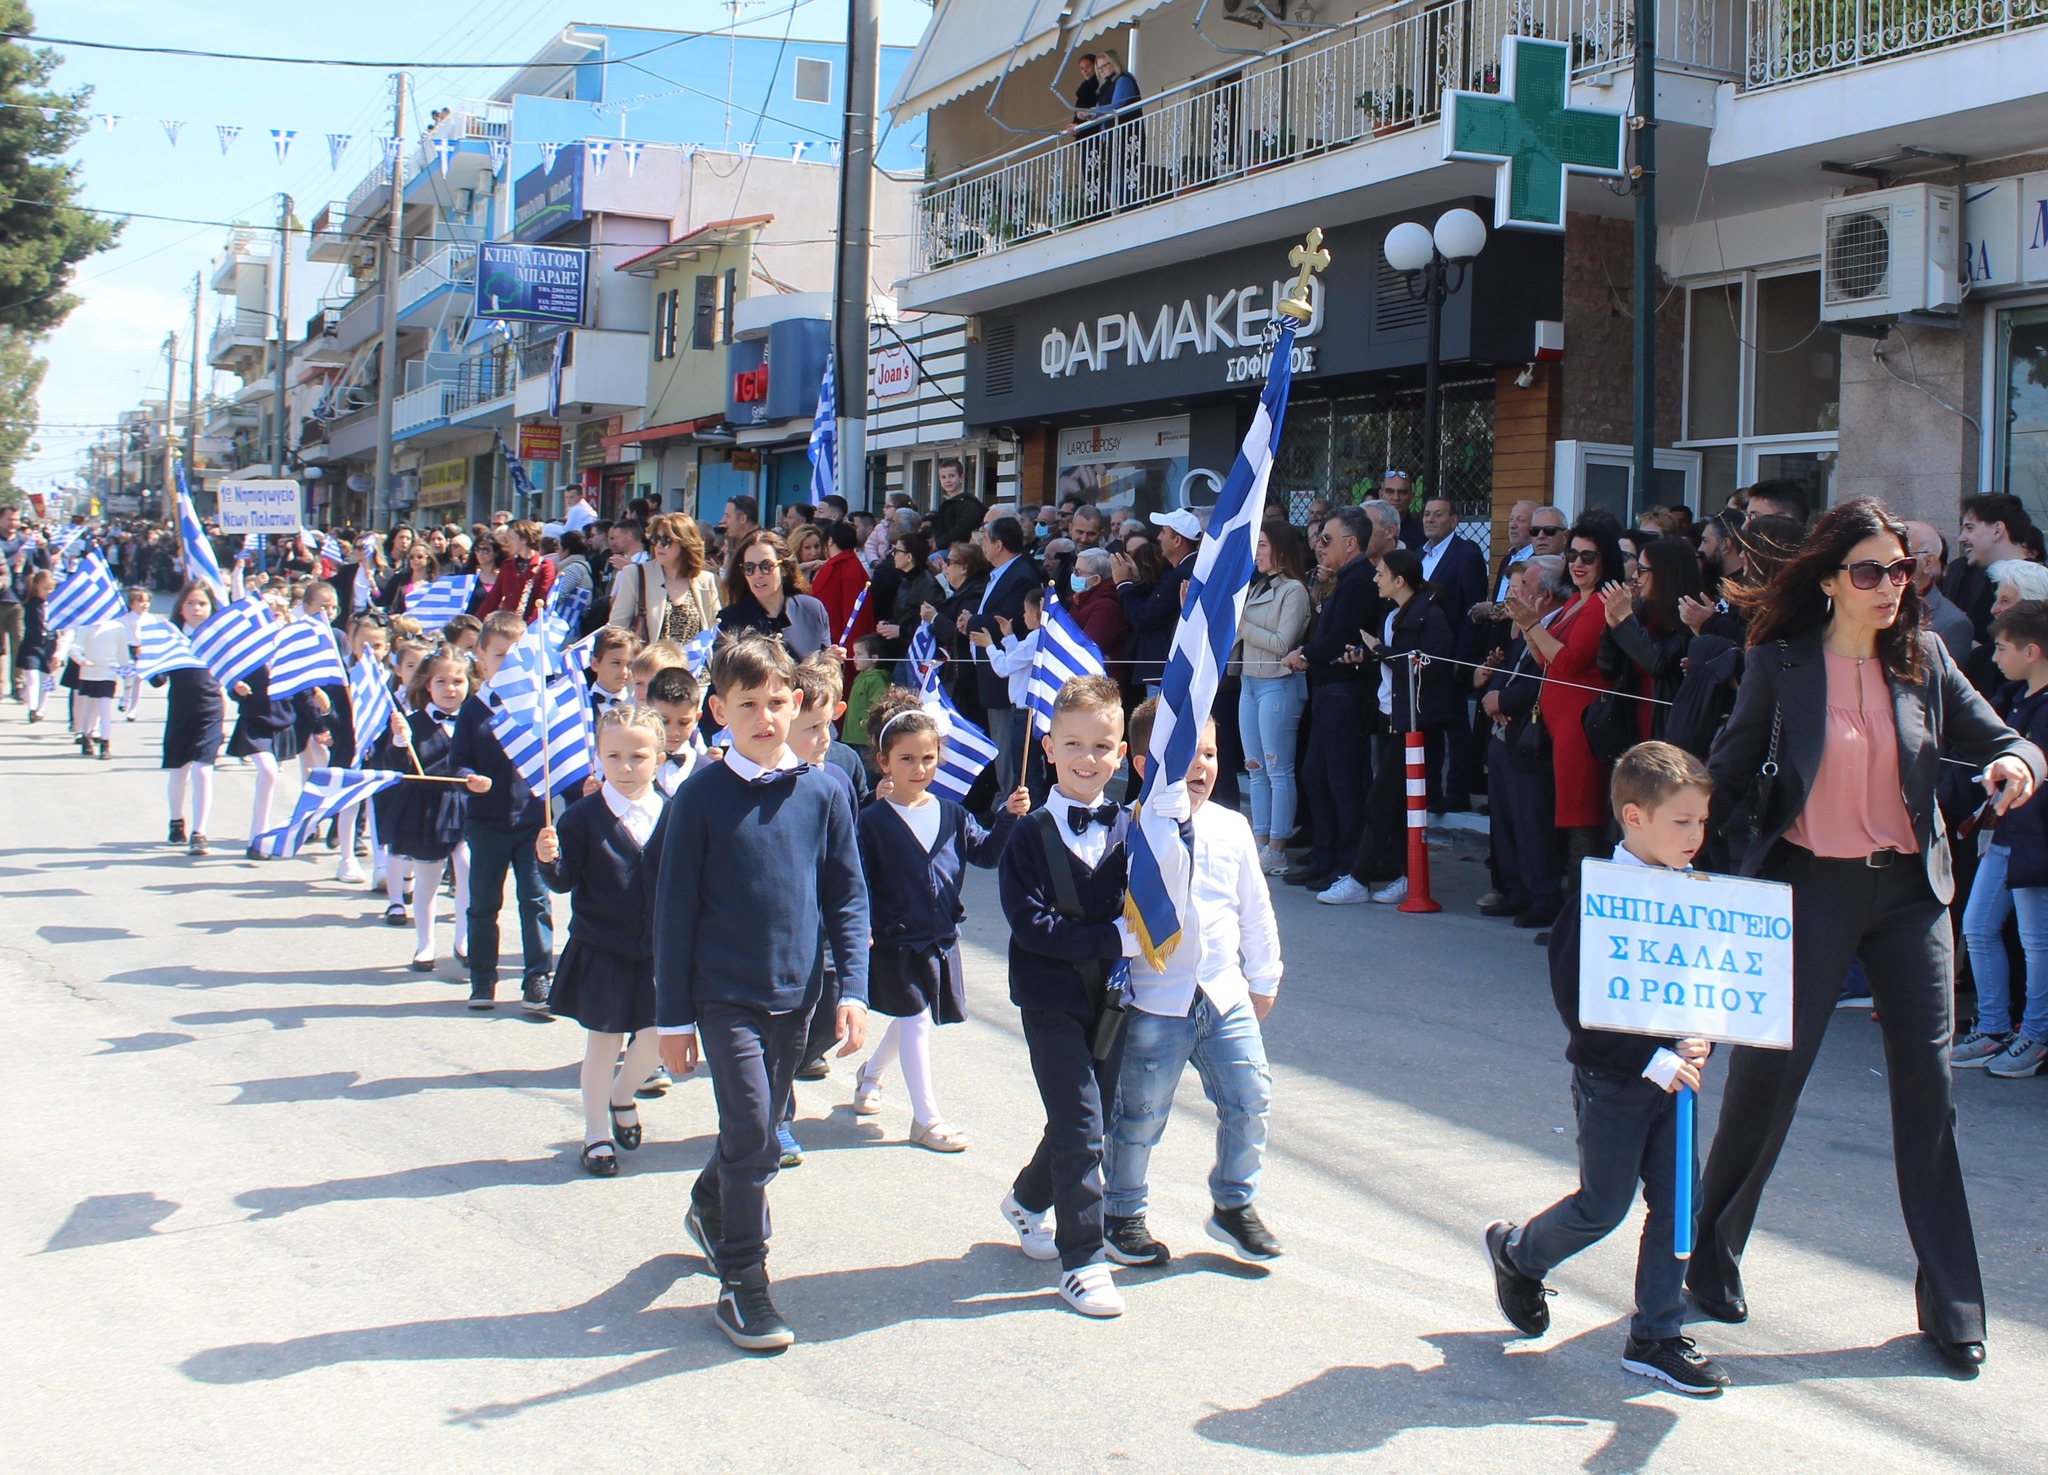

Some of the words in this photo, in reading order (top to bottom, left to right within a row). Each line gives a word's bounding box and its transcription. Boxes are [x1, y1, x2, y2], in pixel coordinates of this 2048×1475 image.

[484, 247, 579, 269] ΚΤΗΜΑΤΑΓΟΡΑ
[518, 267, 578, 286] ΜΠΑΡΔΗΣ
[1041, 274, 1325, 378] ΦΑΡΜΑΚΕΙΟ
[878, 358, 910, 385] Joan's
[1226, 345, 1316, 383] ΣΟΦΙΟΣ
[234, 486, 294, 506] Νηπιαγωγείο
[223, 511, 248, 527] Νέων
[251, 510, 295, 527] Παλατίων
[1584, 893, 1792, 940] ΝΗΠΙΑΓΩΓΕΙΟ
[1608, 935, 1763, 977] ΣΚΑΛΑΣ
[1607, 976, 1767, 1015] ΩΡΩΠΟΥ
